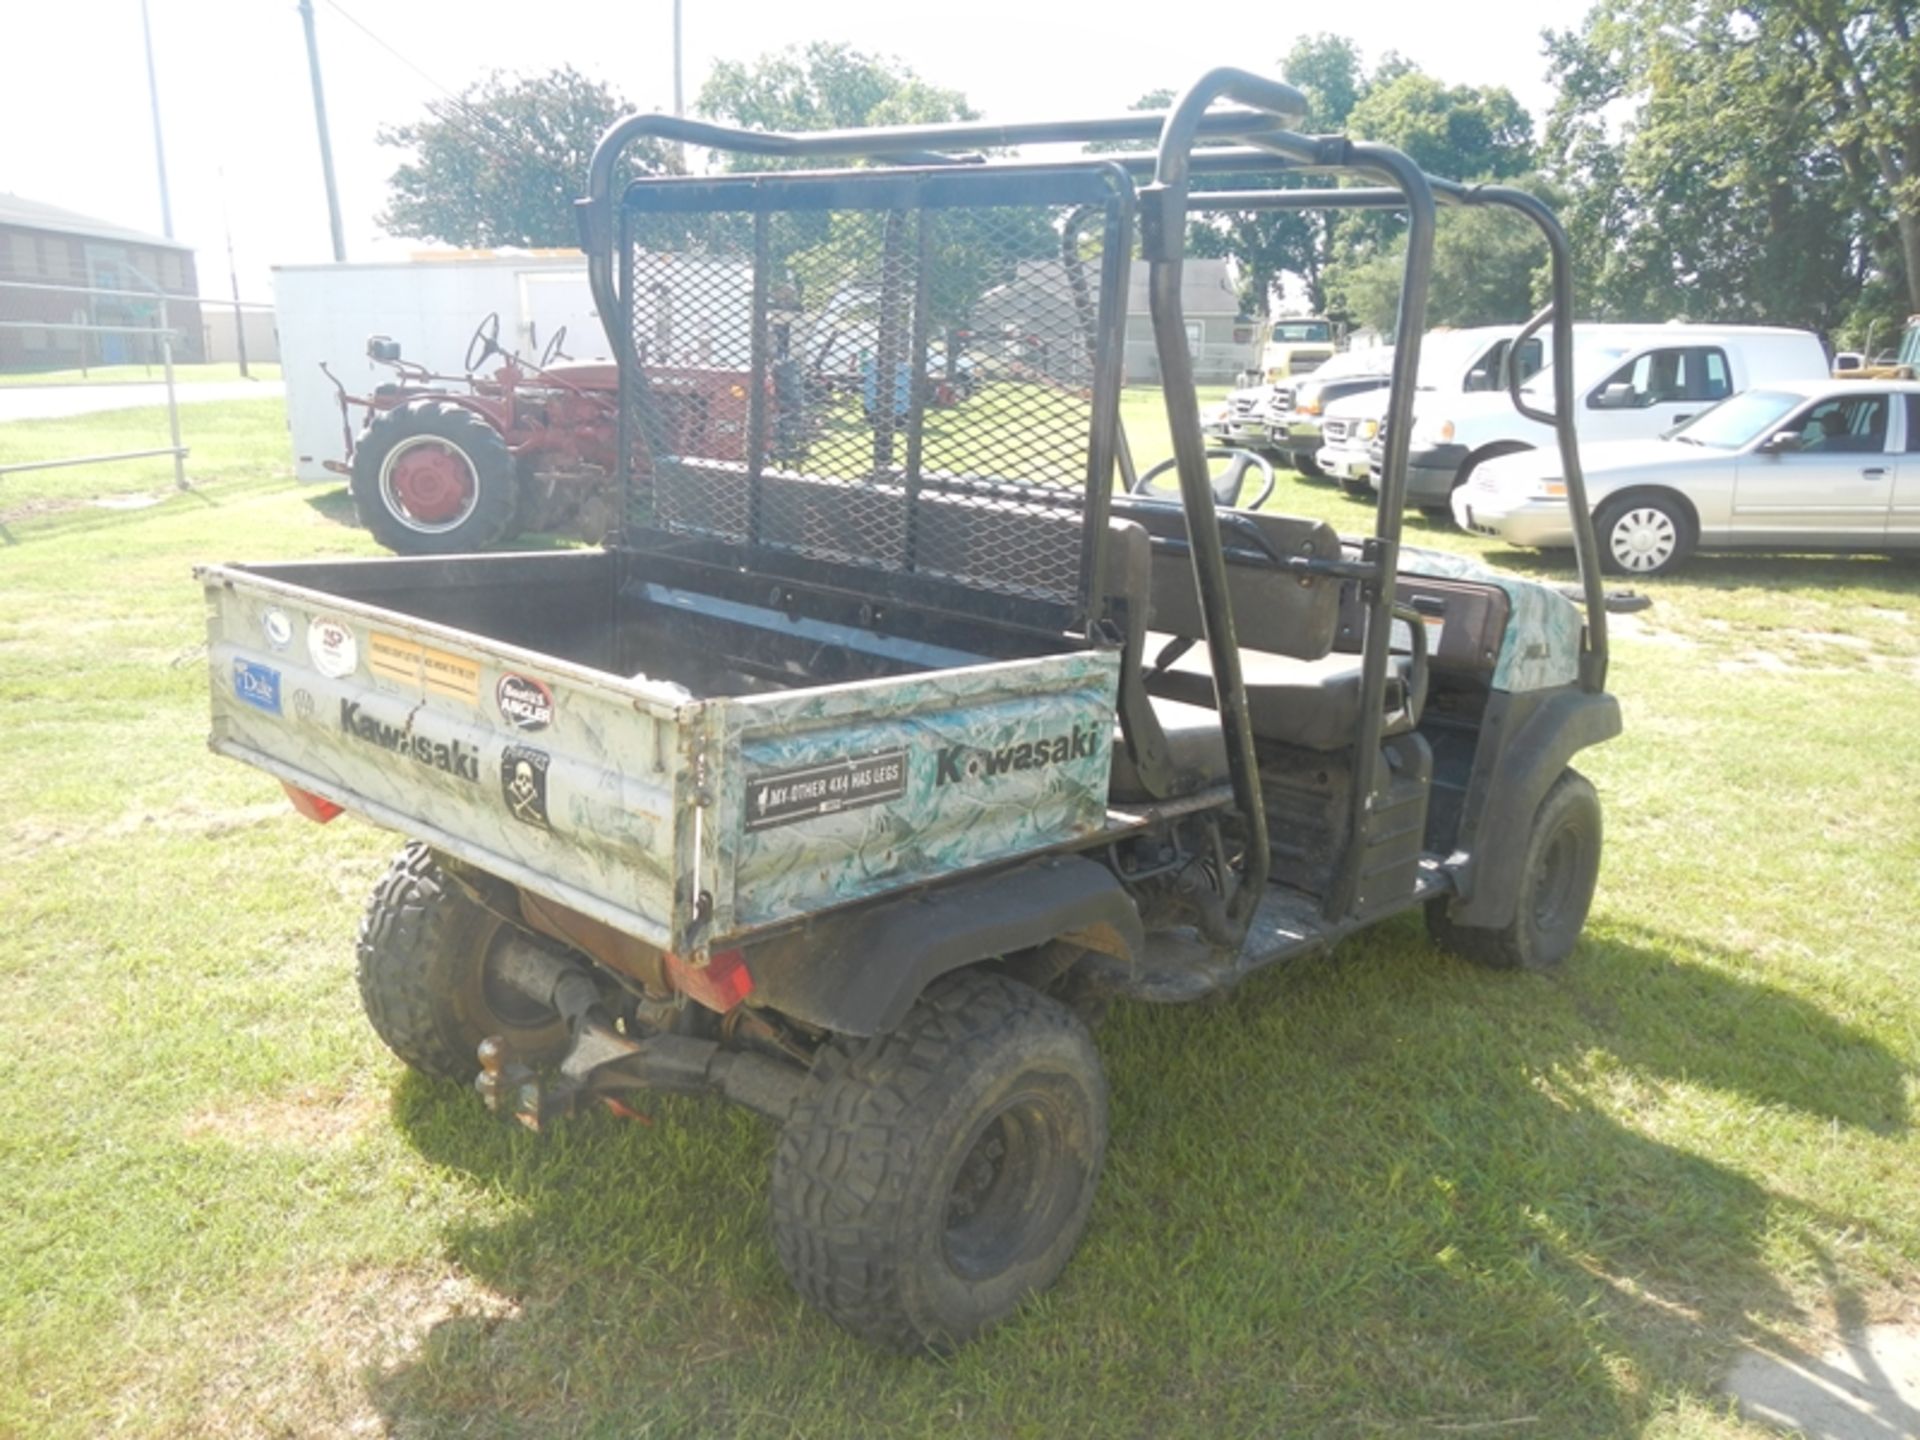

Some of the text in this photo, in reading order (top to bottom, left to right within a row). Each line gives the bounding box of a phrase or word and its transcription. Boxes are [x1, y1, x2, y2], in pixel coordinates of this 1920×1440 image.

[501, 698, 551, 724] ANGLER
[936, 720, 1098, 787] Kwasaki
[770, 787, 788, 806] MY
[791, 780, 827, 802] OTHER
[852, 768, 872, 789] HAS
[873, 764, 899, 784] LEGS
